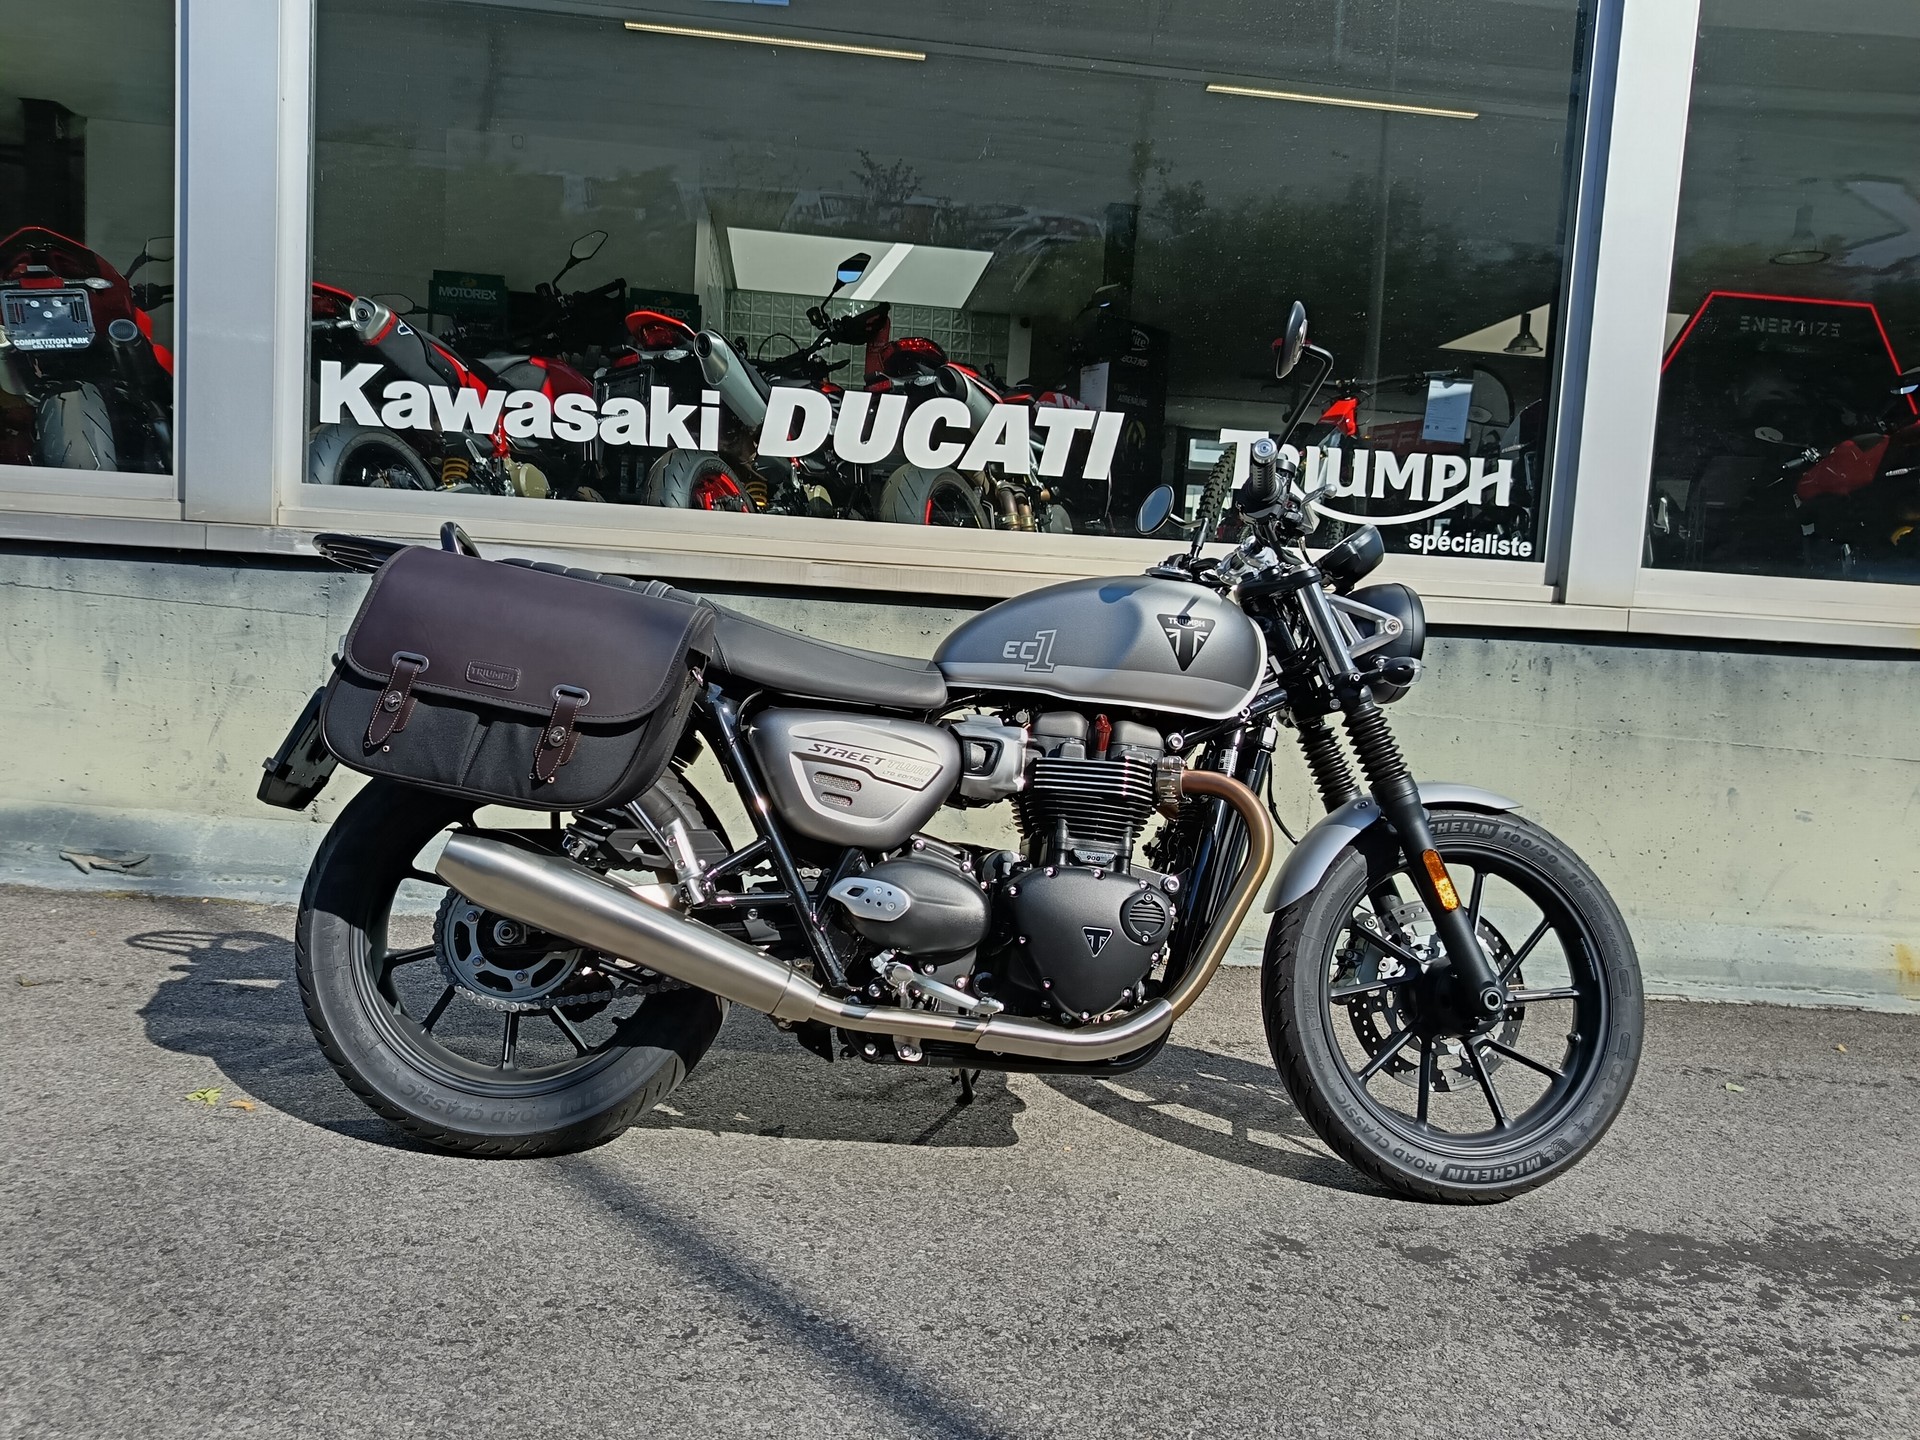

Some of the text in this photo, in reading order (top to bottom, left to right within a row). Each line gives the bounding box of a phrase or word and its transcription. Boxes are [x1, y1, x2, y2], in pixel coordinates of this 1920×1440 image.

[438, 286, 497, 301] MOTOREX
[13, 337, 66, 346] COMPETITION
[319, 360, 720, 452] Kawasaki
[757, 386, 1125, 480] DUCATI
[1408, 530, 1532, 557] spécialiste
[1168, 617, 1206, 629] TRIUMPH
[1002, 629, 1058, 672] EC1
[471, 666, 515, 682] TRIUMPH
[808, 743, 886, 765] STREET
[896, 771, 925, 783] EDITION
[1429, 820, 1495, 837] CHELIN
[1501, 831, 1559, 864] 100/90
[1568, 872, 1586, 889] 18
[1334, 1091, 1542, 1182] MICHELIN ROAD CLASSIC
